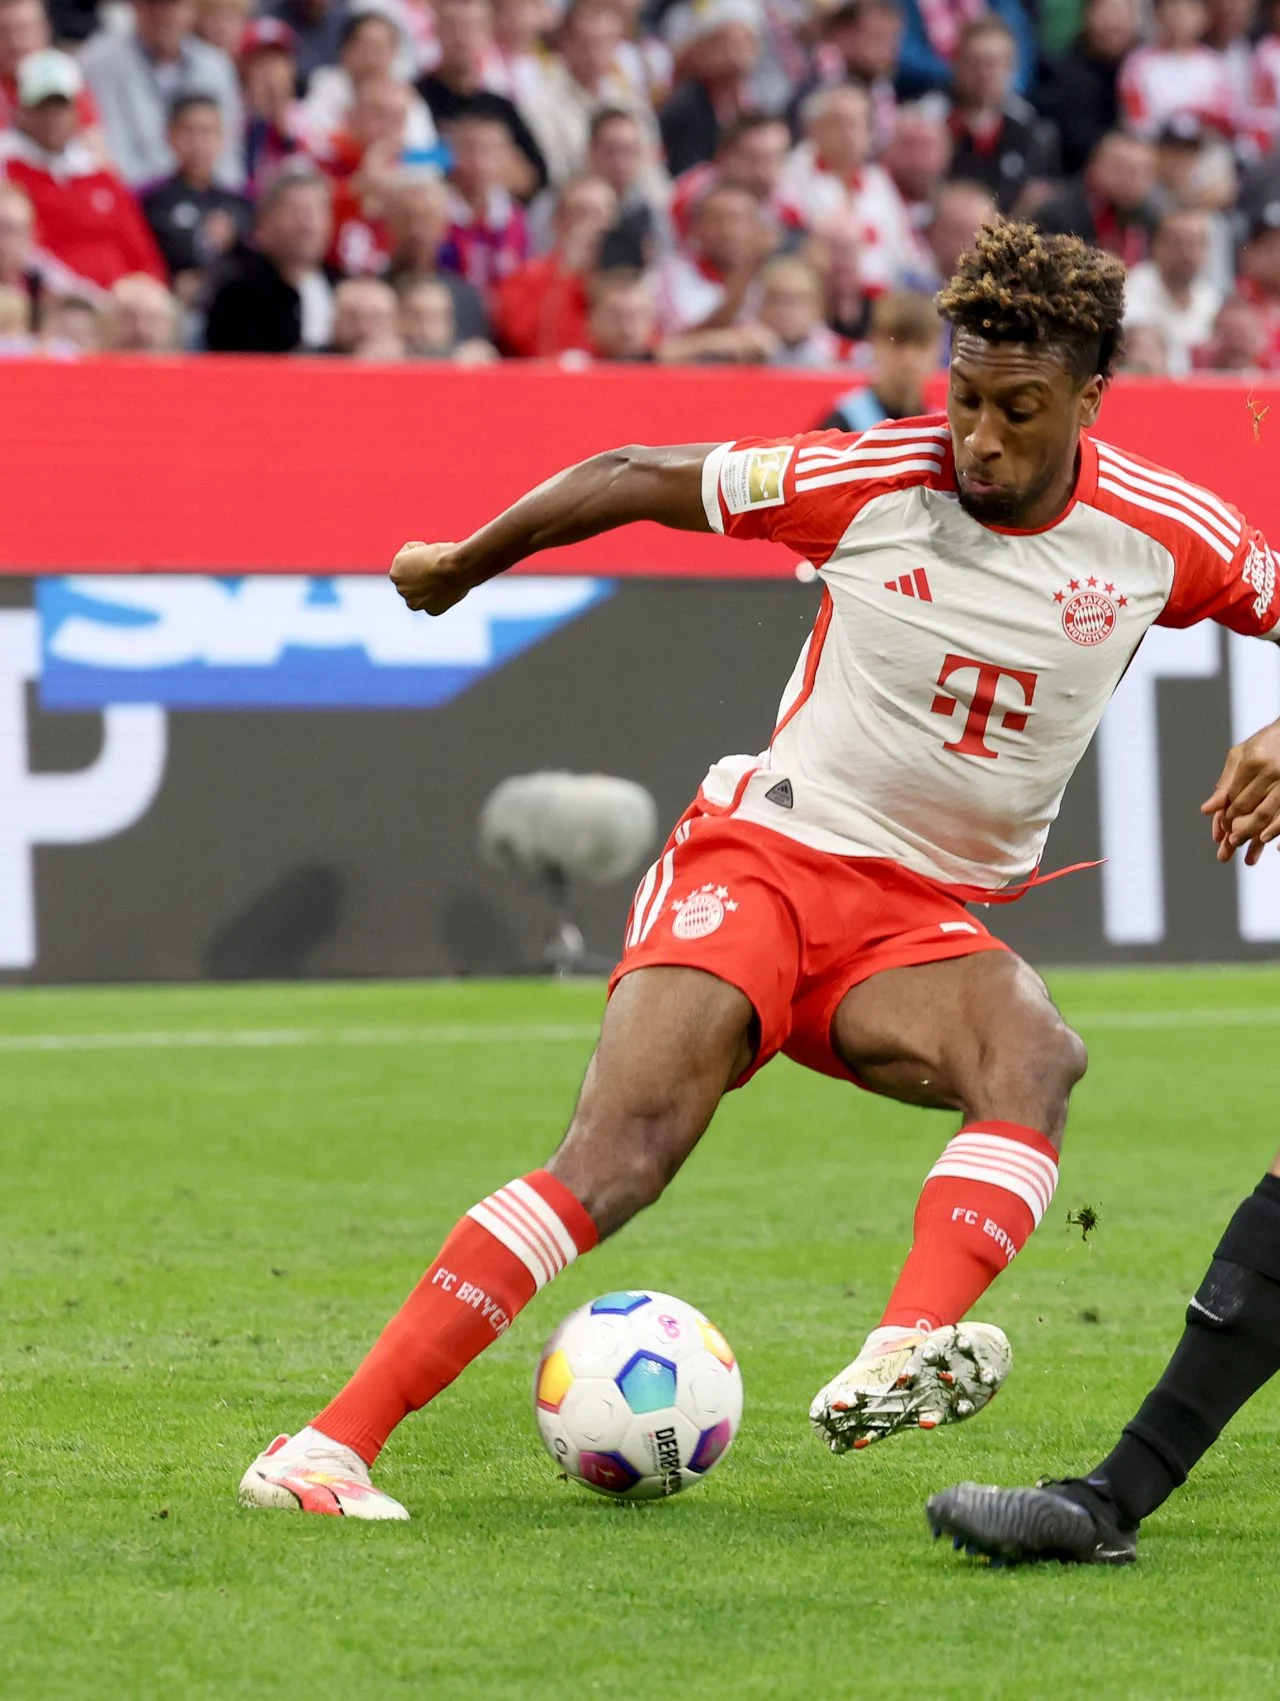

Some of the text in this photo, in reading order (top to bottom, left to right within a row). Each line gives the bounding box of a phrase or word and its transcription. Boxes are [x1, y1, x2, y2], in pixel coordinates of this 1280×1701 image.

[1079, 595, 1113, 617] BAYERN
[951, 1207, 979, 1225] FC
[431, 1267, 457, 1292] FC
